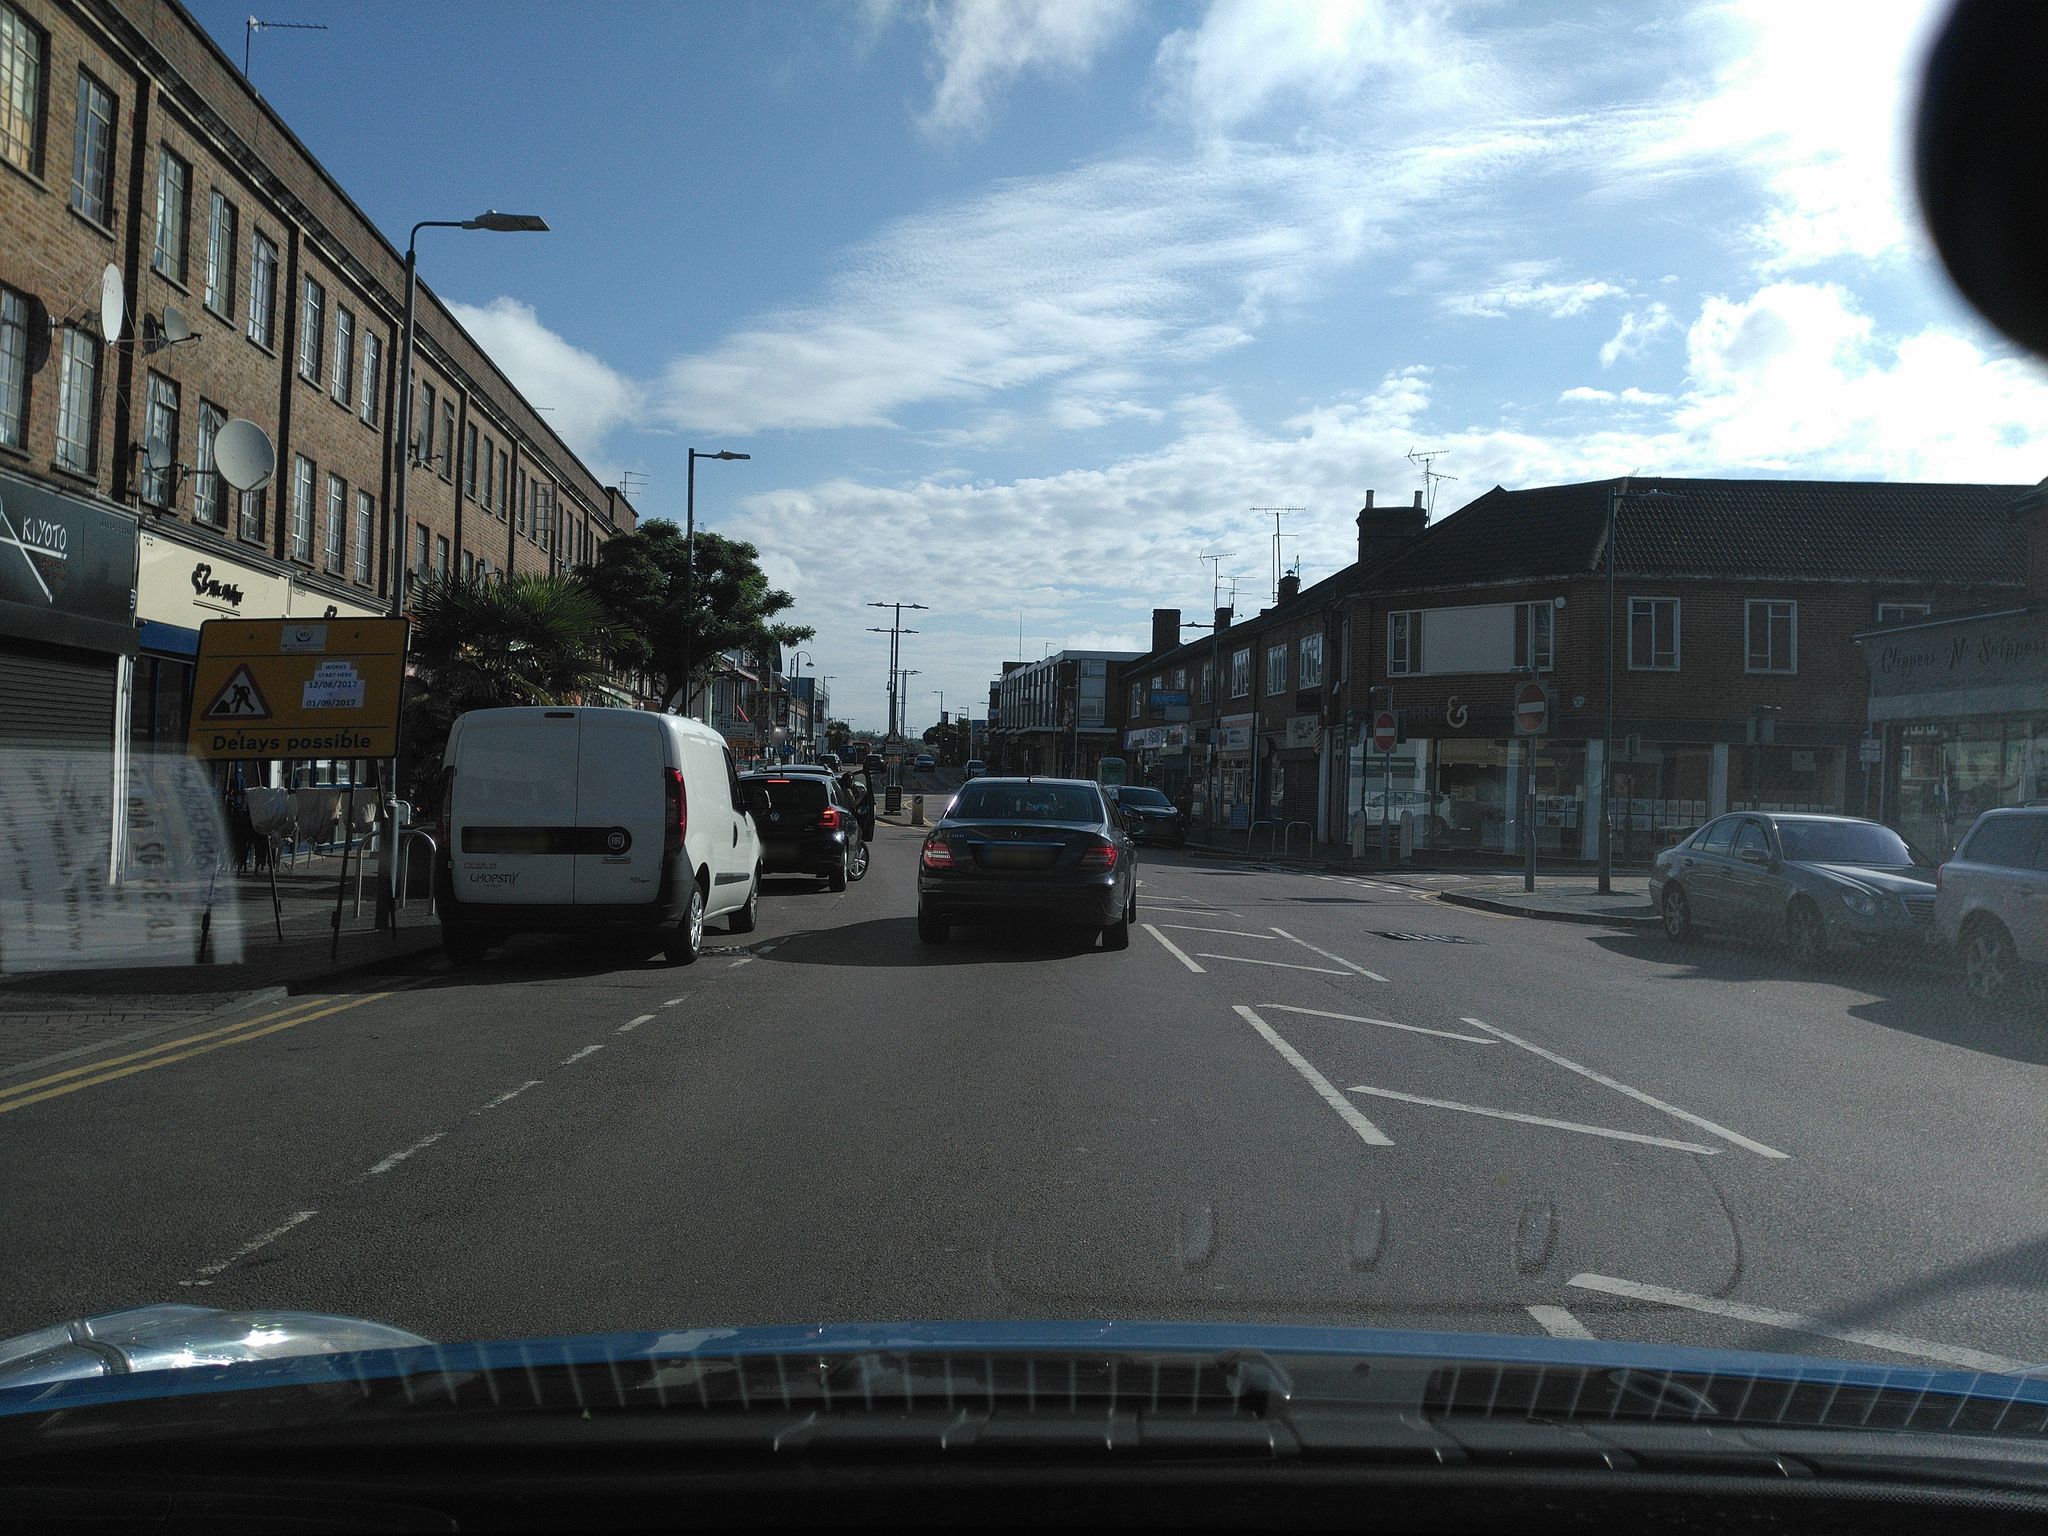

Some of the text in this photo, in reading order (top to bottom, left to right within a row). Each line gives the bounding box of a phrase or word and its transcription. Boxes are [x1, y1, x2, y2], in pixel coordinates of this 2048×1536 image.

[23, 516, 67, 550] KIYOTO
[308, 680, 357, 689] 12/08/2017
[306, 699, 356, 708] 01/09/2017
[213, 734, 371, 753] Delays possible
